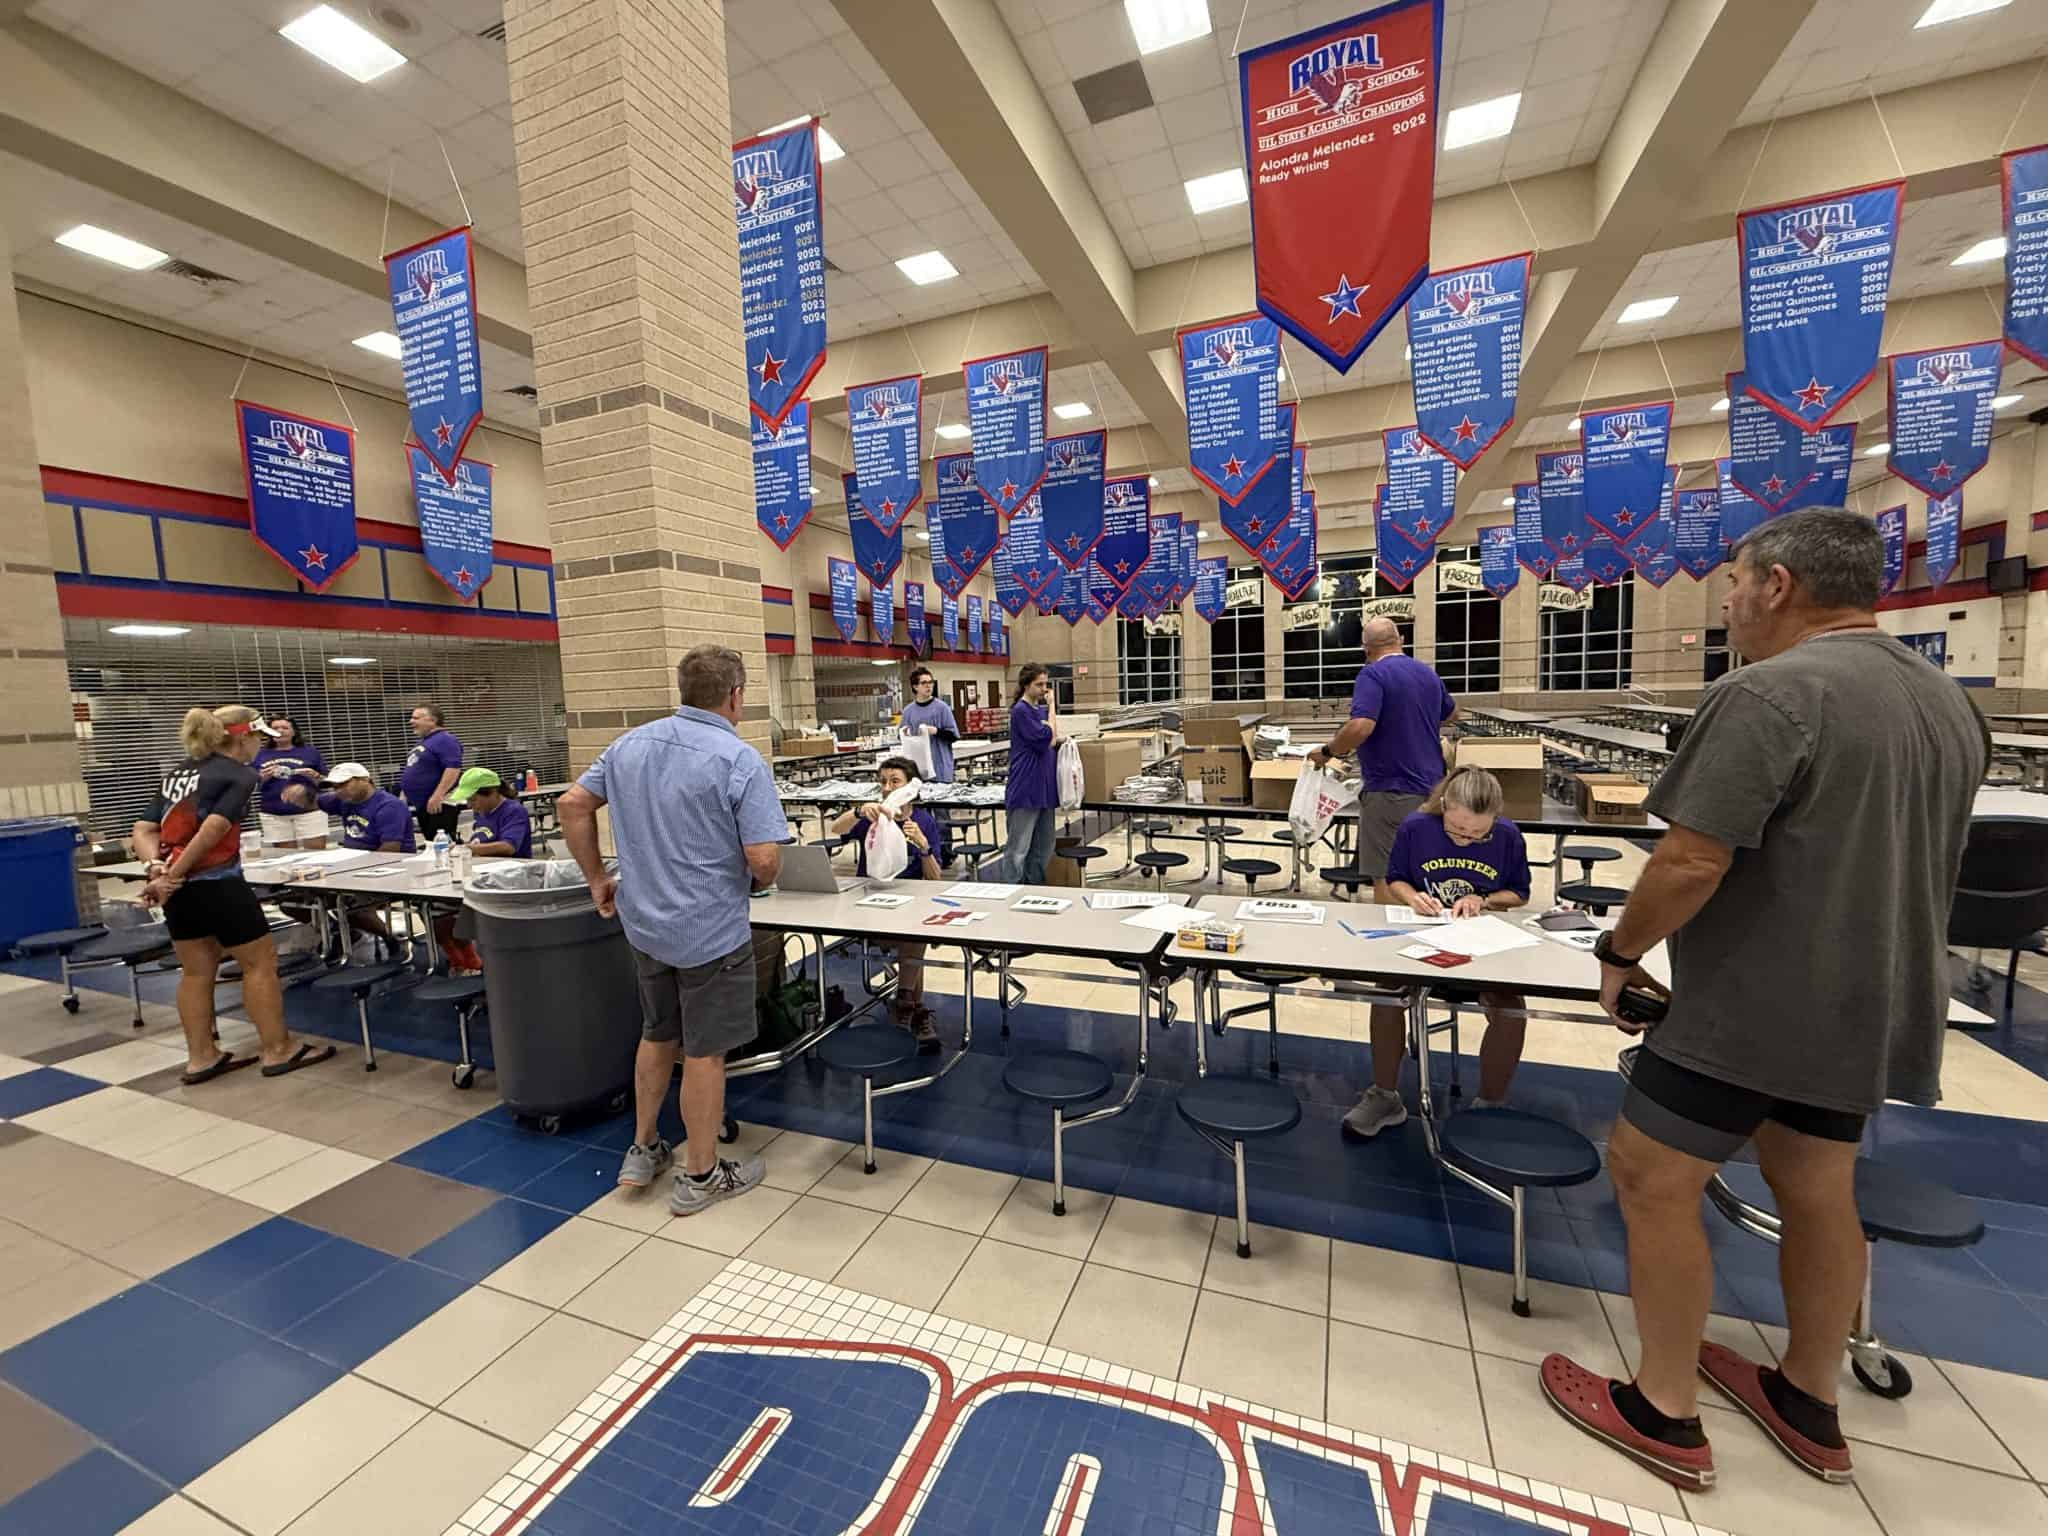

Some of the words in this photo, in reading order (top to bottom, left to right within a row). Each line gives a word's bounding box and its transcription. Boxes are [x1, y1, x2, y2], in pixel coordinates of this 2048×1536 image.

[1289, 33, 1384, 97] ROYAL
[1266, 103, 1299, 121] HIGH
[1367, 66, 1419, 89] SCHOOL
[1258, 136, 1278, 150] UIL
[1278, 131, 1307, 146] STATE
[1307, 114, 1361, 137] ACADEMIC
[1361, 92, 1425, 120] CHAMPIONS
[1259, 150, 1309, 173] Alondra
[1313, 131, 1376, 156] Melendez
[1391, 112, 1427, 135] 2022
[733, 150, 783, 180] OYAL
[1259, 169, 1290, 184] Ready
[1293, 158, 1330, 176] Writing
[794, 220, 817, 235] 2021
[1777, 203, 1857, 243] ROYAL
[1758, 246, 1785, 257] HIGH
[1841, 227, 1885, 241] SCHOOL
[407, 250, 448, 288] ROYAL
[742, 259, 785, 275] Melendez
[797, 247, 821, 261] 2022
[798, 259, 822, 274] 2022
[1434, 271, 1495, 305] ROYAL
[1750, 278, 1789, 293] Ramsey
[1792, 273, 1825, 287] Alfaro
[1862, 260, 1889, 273] 2019
[1750, 288, 1794, 302] Veronica
[1797, 282, 1835, 295] Chavez
[1861, 271, 1888, 283] 2021
[2014, 274, 2047, 286] Tracy
[1750, 300, 1783, 312] Camila
[1860, 282, 1887, 294] 2021
[743, 313, 774, 328] endoza
[1750, 311, 1783, 323] Camila
[744, 325, 776, 341] endoza
[1204, 327, 1254, 357] ROYAL
[270, 420, 327, 451] ROYAL
[162, 774, 200, 804] USA
[1421, 857, 1498, 881] VOLUNTEER
